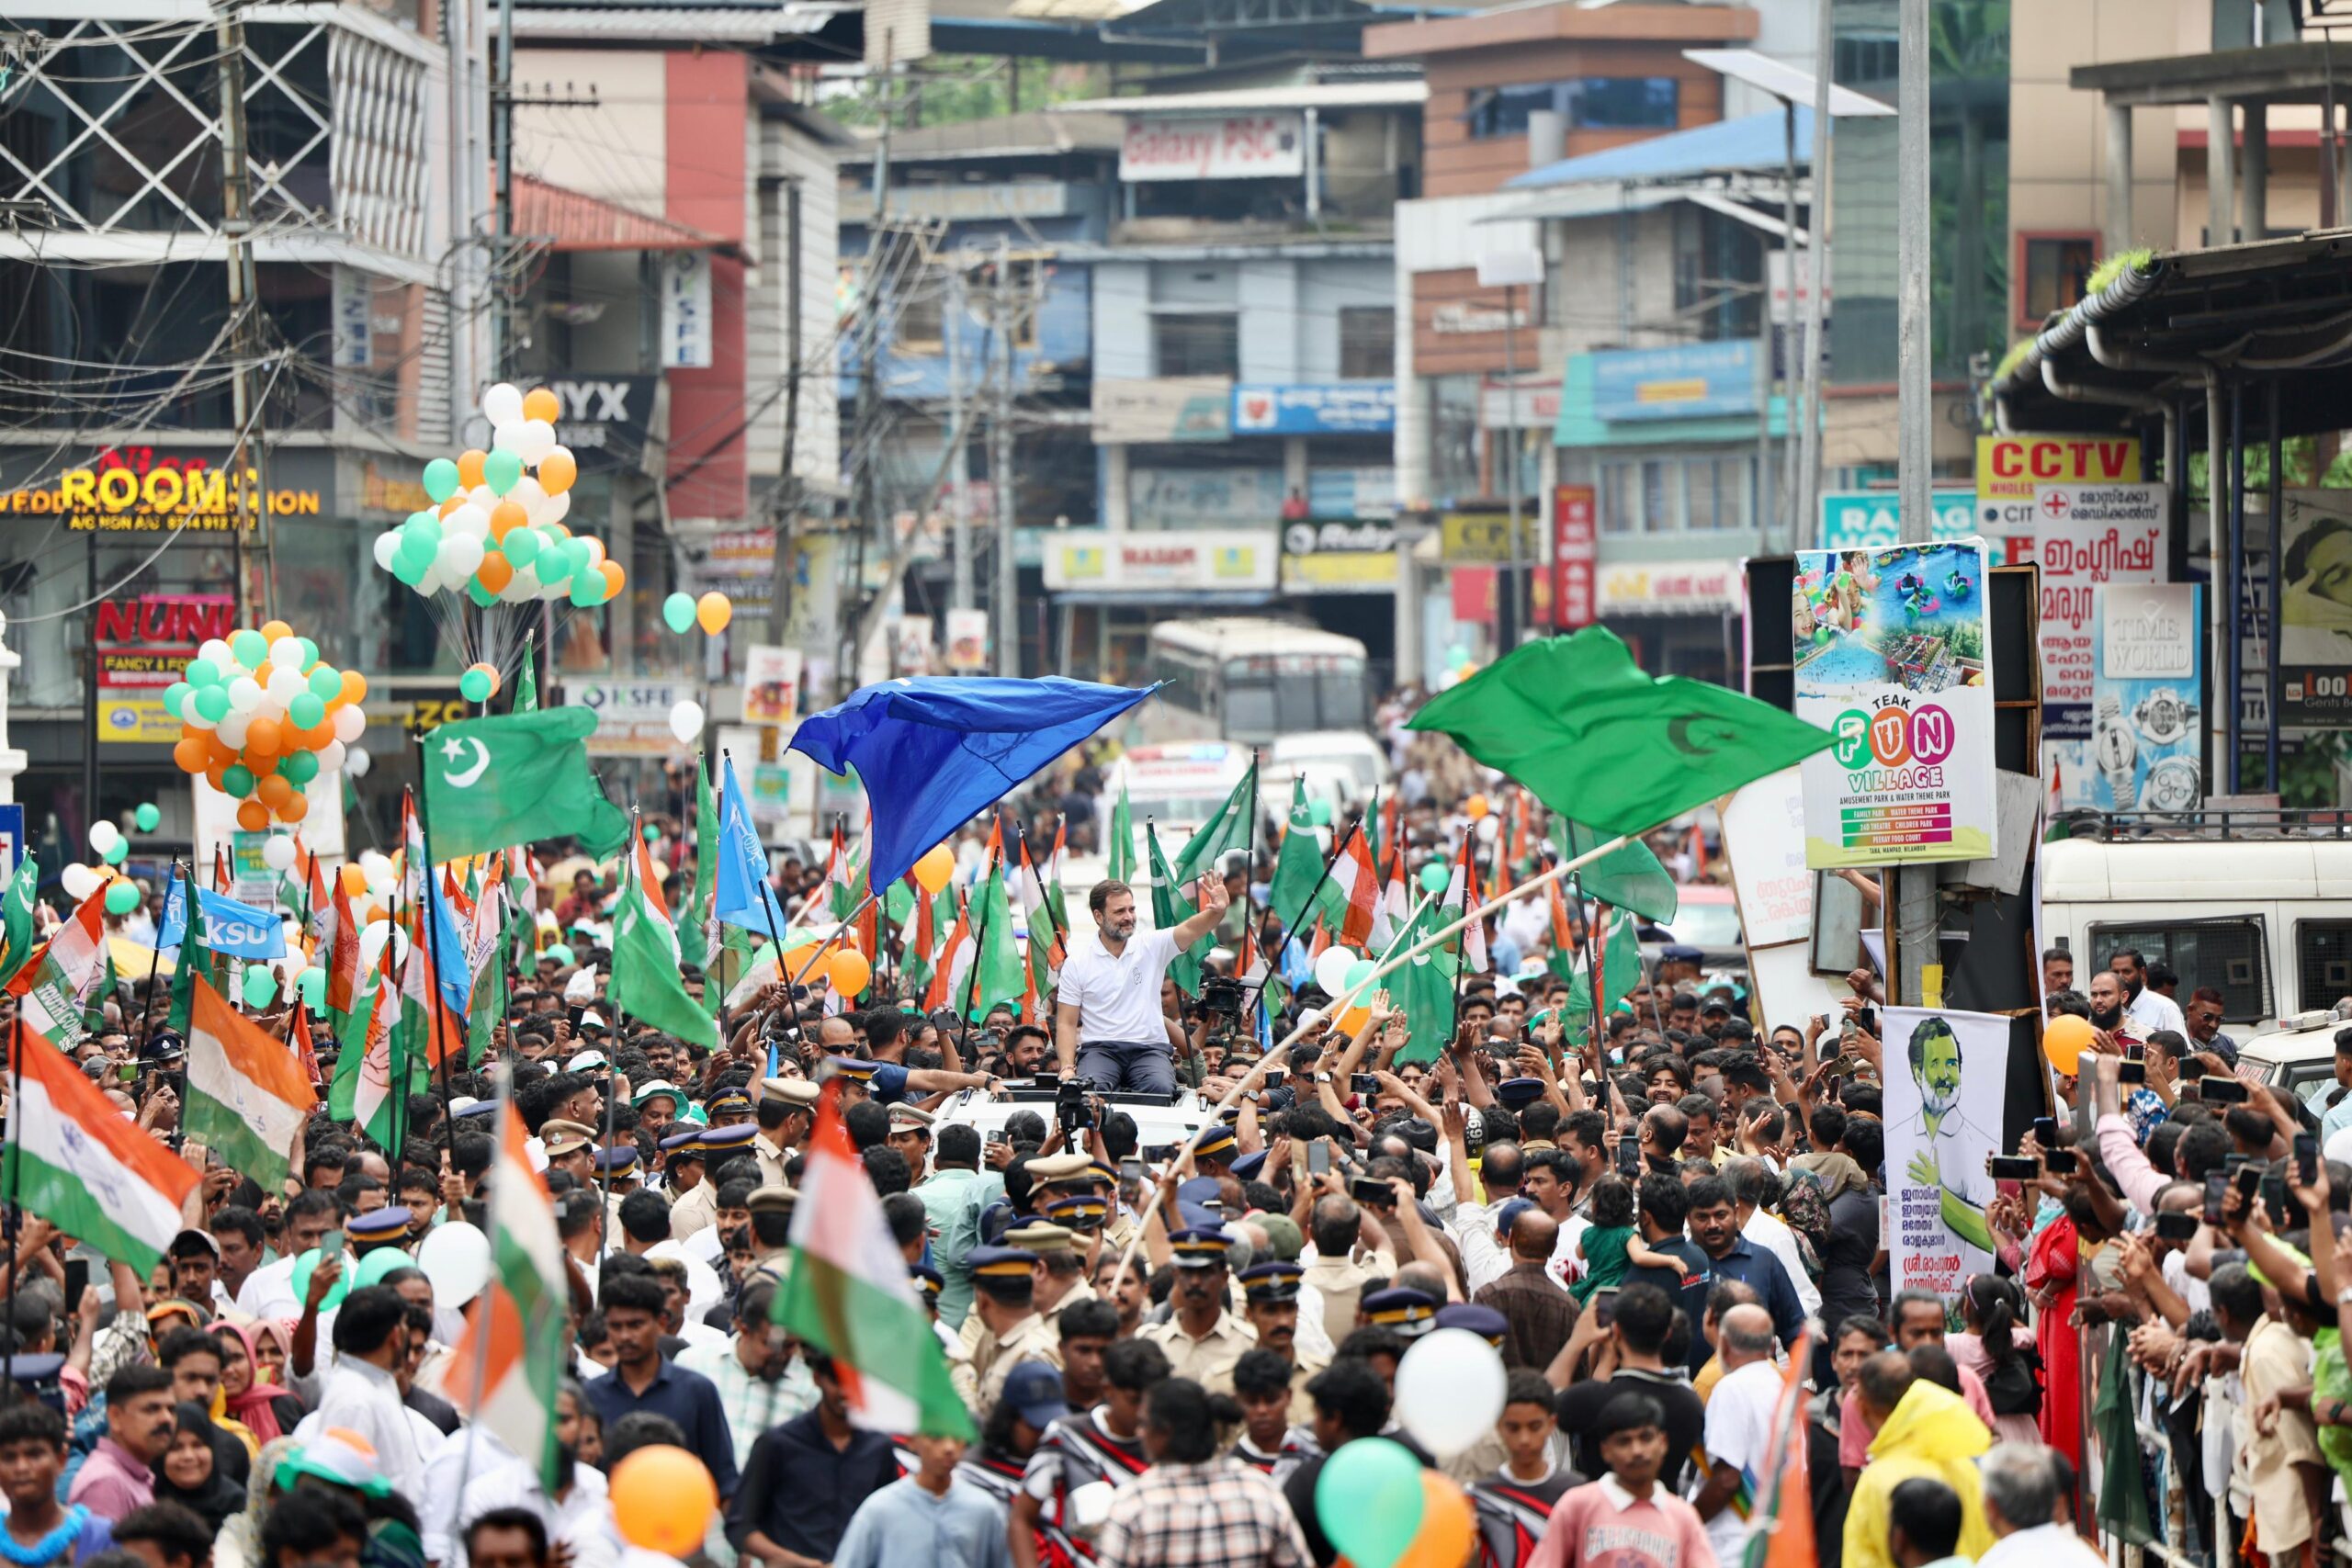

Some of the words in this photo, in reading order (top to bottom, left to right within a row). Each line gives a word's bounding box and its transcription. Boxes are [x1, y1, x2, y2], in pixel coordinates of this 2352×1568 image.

[1992, 442, 2130, 479] CCTV
[1989, 481, 2033, 495] WHOLES
[2113, 617, 2180, 641] TIME
[2109, 645, 2190, 671] WORLD
[1872, 694, 1911, 710] TEAK
[2304, 698, 2340, 709] Gents
[1838, 711, 1946, 762] FUN
[1848, 765, 1943, 793] VILLAGE
[1839, 795, 1872, 805] AMUSEMENT
[1873, 794, 1889, 804] PARK
[1890, 794, 1894, 802] &
[1895, 793, 1915, 802] WATER
[1916, 792, 1934, 801] THEME
[1935, 790, 1951, 800] PARK
[1853, 810, 1871, 818] FAMILY
[1871, 808, 1885, 818] PARK
[1890, 807, 1907, 816] WATER
[1908, 807, 1924, 815] THEME
[1925, 806, 1939, 814] PARK
[1871, 821, 1891, 830] THEATRE
[1894, 819, 1919, 829] CHILDREN
[1919, 818, 1933, 828] PARK
[1891, 834, 1905, 842] FOOD
[1905, 833, 1921, 841] COURT
